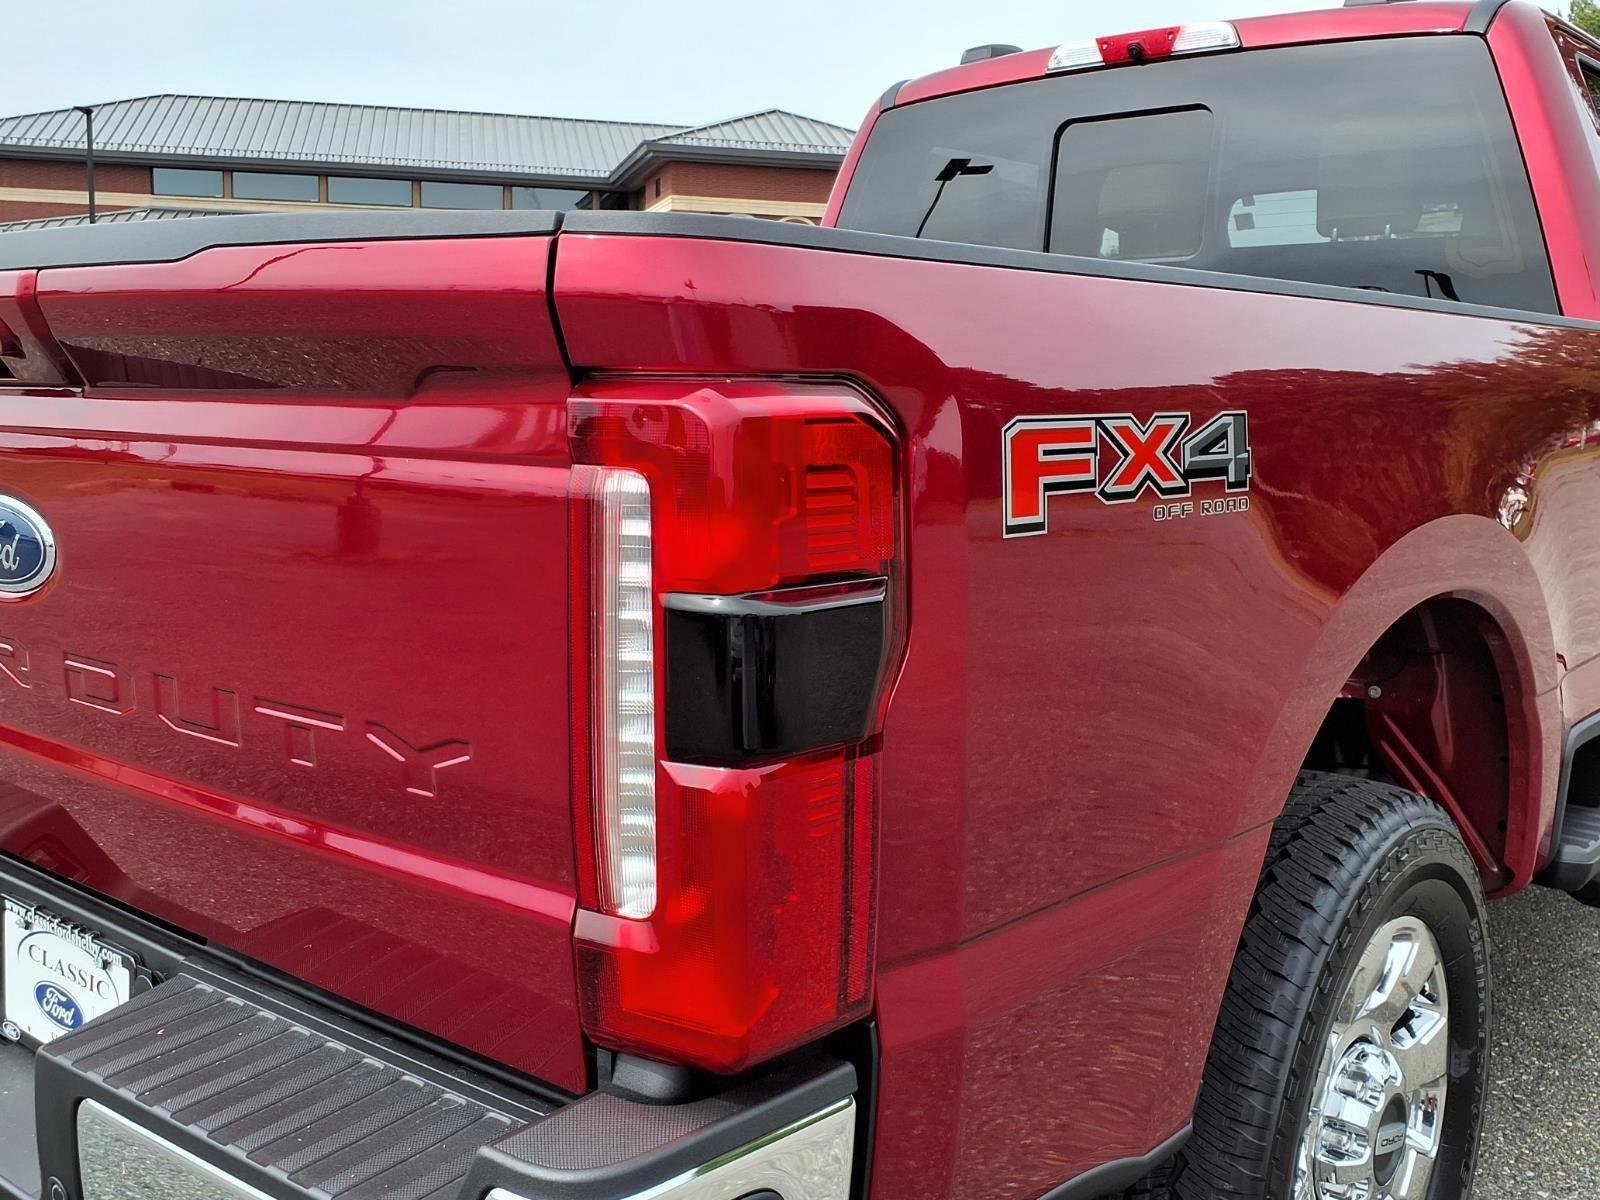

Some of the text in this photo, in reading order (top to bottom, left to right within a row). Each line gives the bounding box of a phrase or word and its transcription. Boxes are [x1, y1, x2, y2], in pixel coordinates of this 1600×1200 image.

[1001, 410, 1252, 538] FX4
[1153, 497, 1250, 521] OFF ROAD
[63, 651, 472, 797] DUTY
[6, 901, 124, 966] www.classicfordshelby.com
[28, 943, 111, 1000] CLASSIC
[42, 986, 75, 1026] Ford
